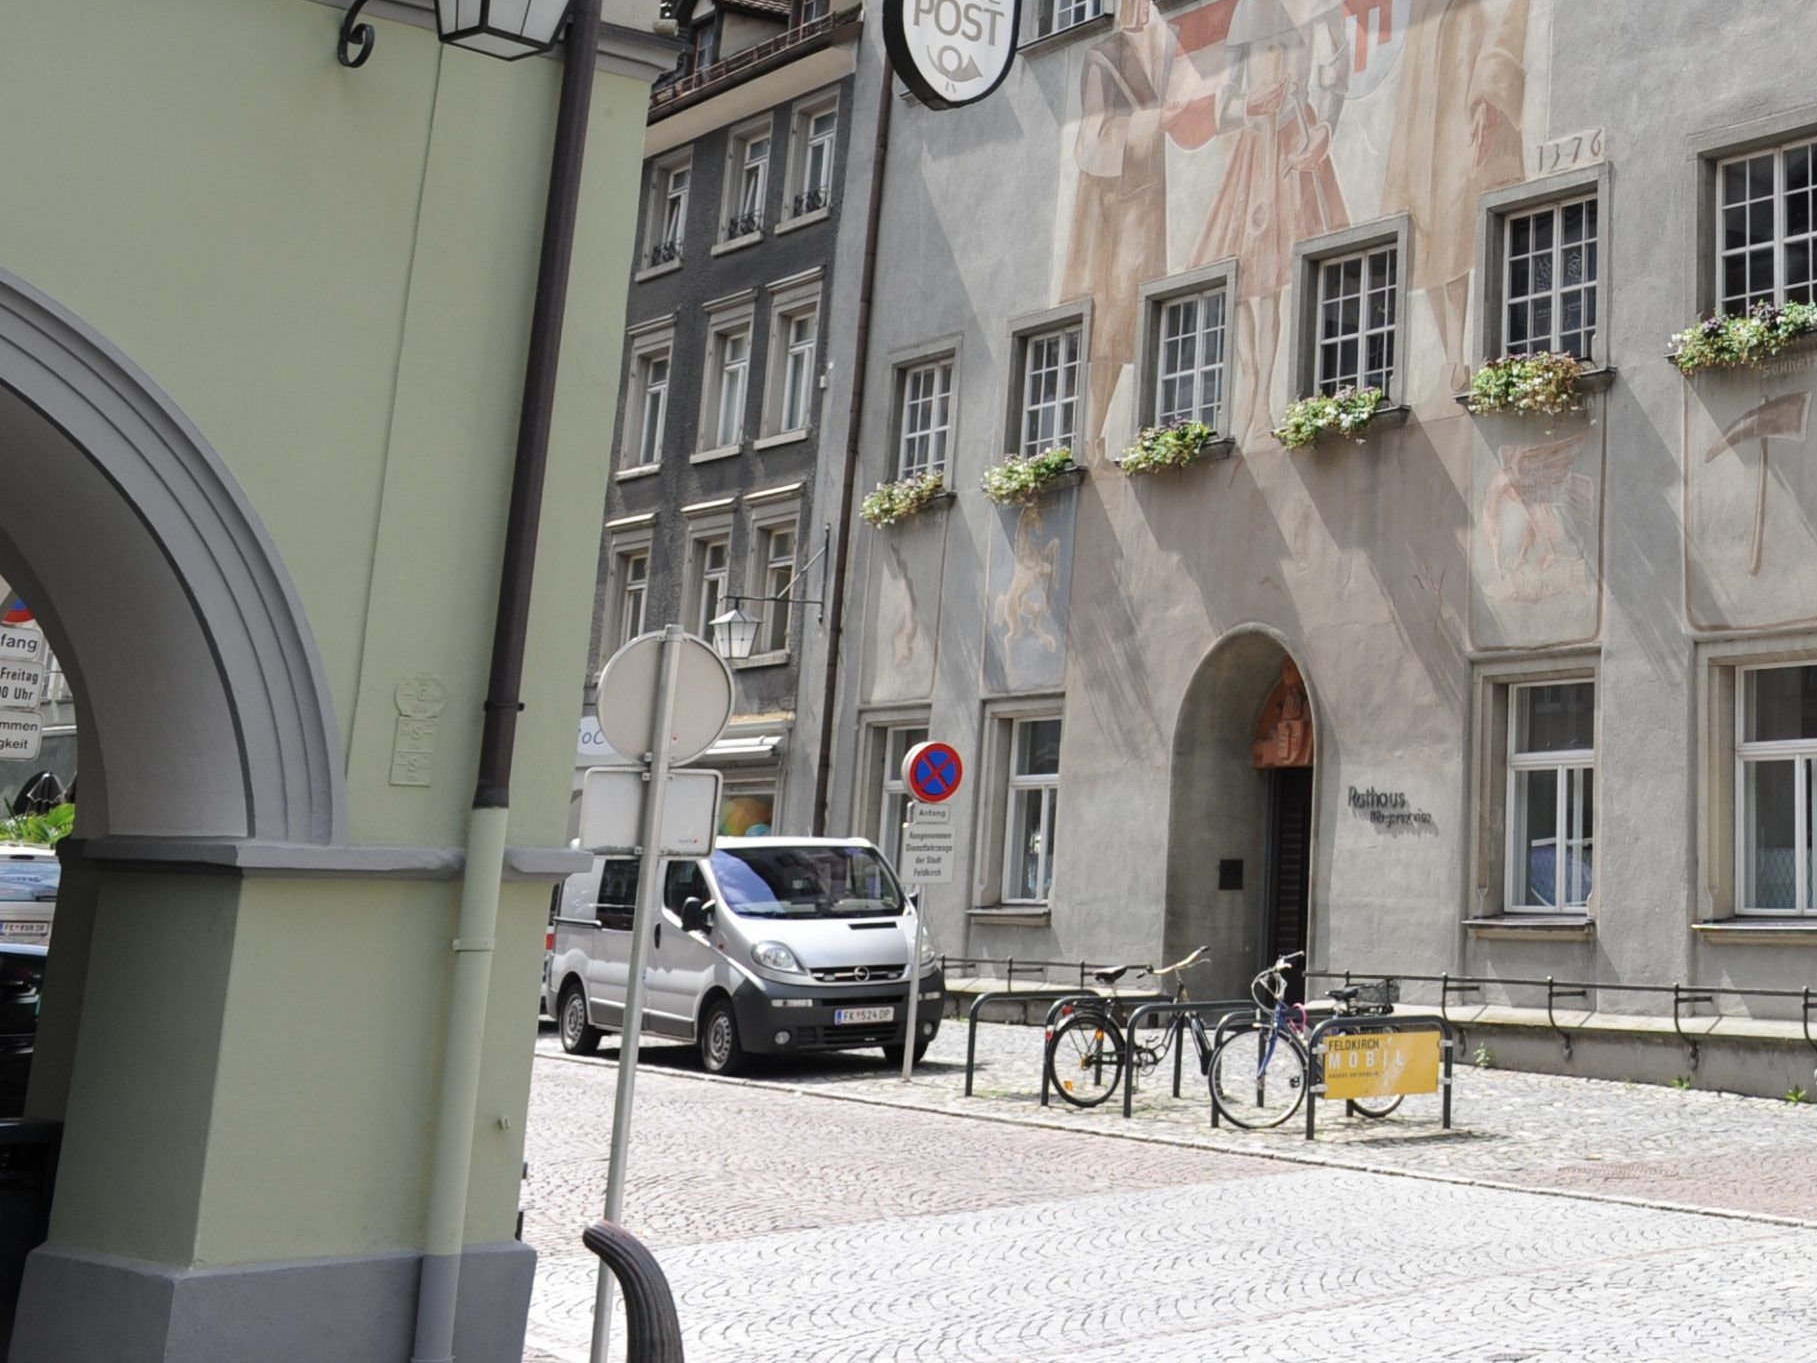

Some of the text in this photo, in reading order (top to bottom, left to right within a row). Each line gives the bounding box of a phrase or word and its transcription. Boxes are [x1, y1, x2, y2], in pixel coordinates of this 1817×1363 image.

[0, 667, 39, 685] Freitag
[14, 687, 34, 701] Uhr
[1348, 785, 1406, 809] Rathaus
[918, 809, 946, 818] Anfang
[1328, 1038, 1380, 1052] FELDKIRCH
